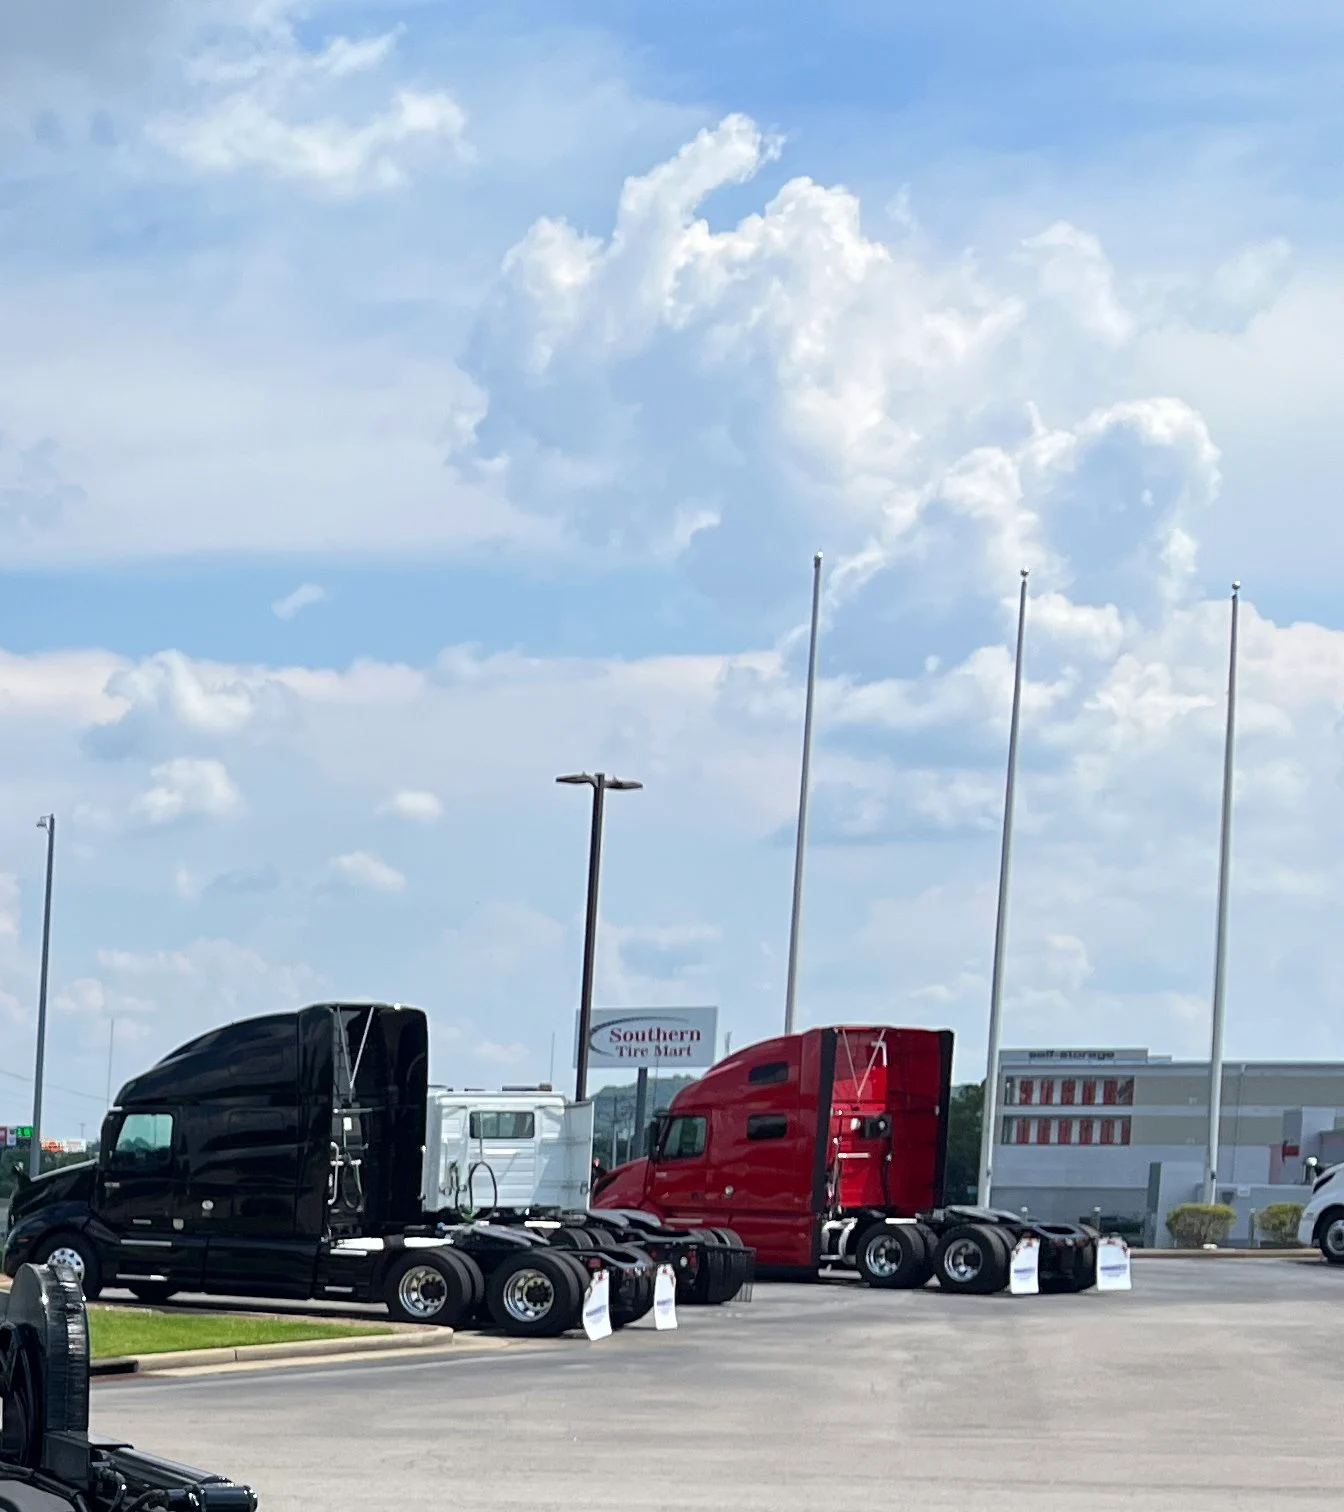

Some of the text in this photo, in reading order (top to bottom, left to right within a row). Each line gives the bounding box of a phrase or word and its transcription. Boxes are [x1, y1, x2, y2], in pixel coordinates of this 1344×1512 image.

[609, 1027, 701, 1043] Southern
[615, 1043, 693, 1058] Tire Mart
